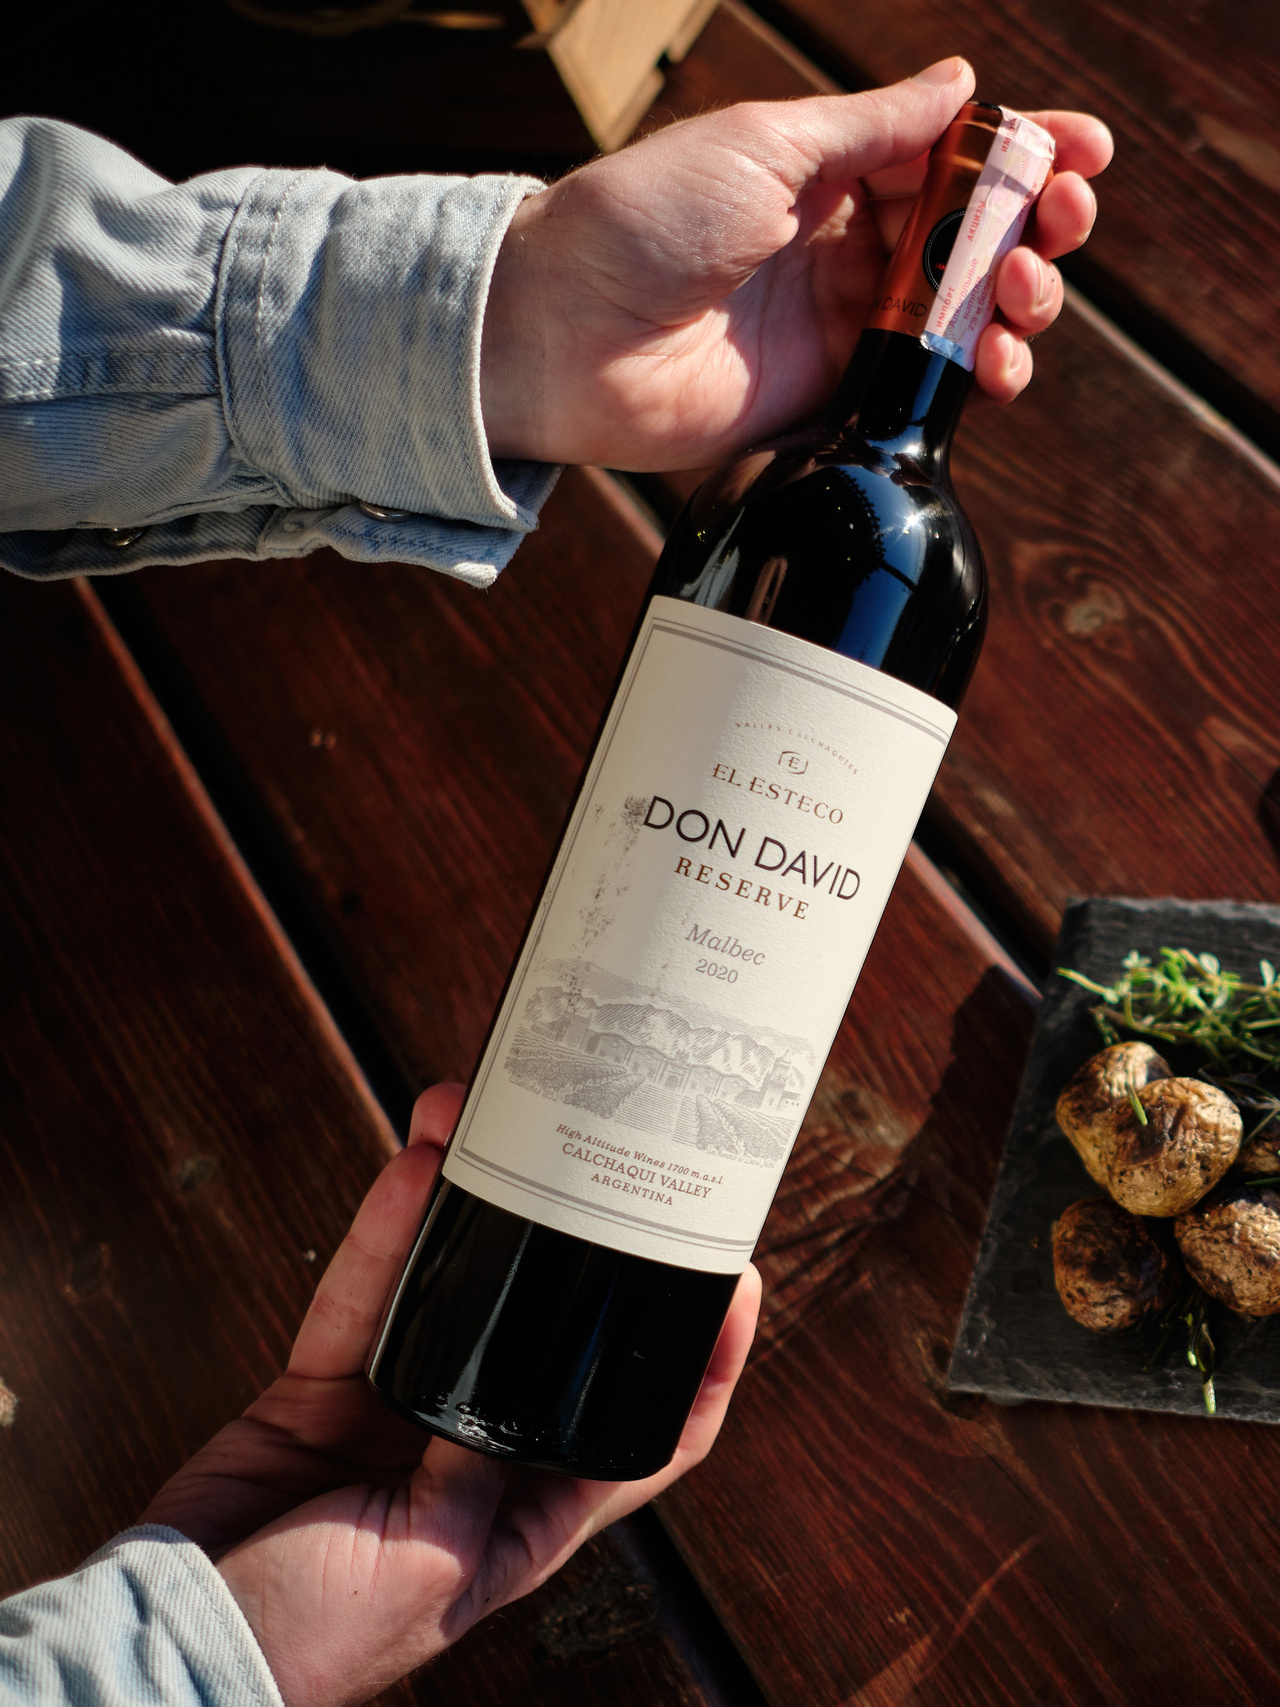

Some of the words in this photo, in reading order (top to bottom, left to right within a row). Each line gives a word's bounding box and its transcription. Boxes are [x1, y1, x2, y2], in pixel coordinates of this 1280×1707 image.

[967, 200, 986, 242] АКЦИЗЫ
[880, 296, 928, 318] DAVID
[936, 286, 956, 329] ИМПОРТ
[713, 763, 742, 787] EL
[749, 776, 844, 824] ESTECO
[643, 795, 746, 859] DON
[754, 836, 861, 900] DAVID
[674, 856, 809, 920] RESERVE
[684, 923, 767, 966] Malbec
[695, 958, 739, 984] 2020
[556, 1123, 582, 1140] High
[583, 1135, 630, 1158] Altitude
[633, 1151, 665, 1169] Wines
[667, 1162, 690, 1176] 1700
[562, 1142, 657, 1184] CALCHAQUI
[660, 1174, 712, 1199] VALLEY
[591, 1172, 673, 1206] ARGENTINA
